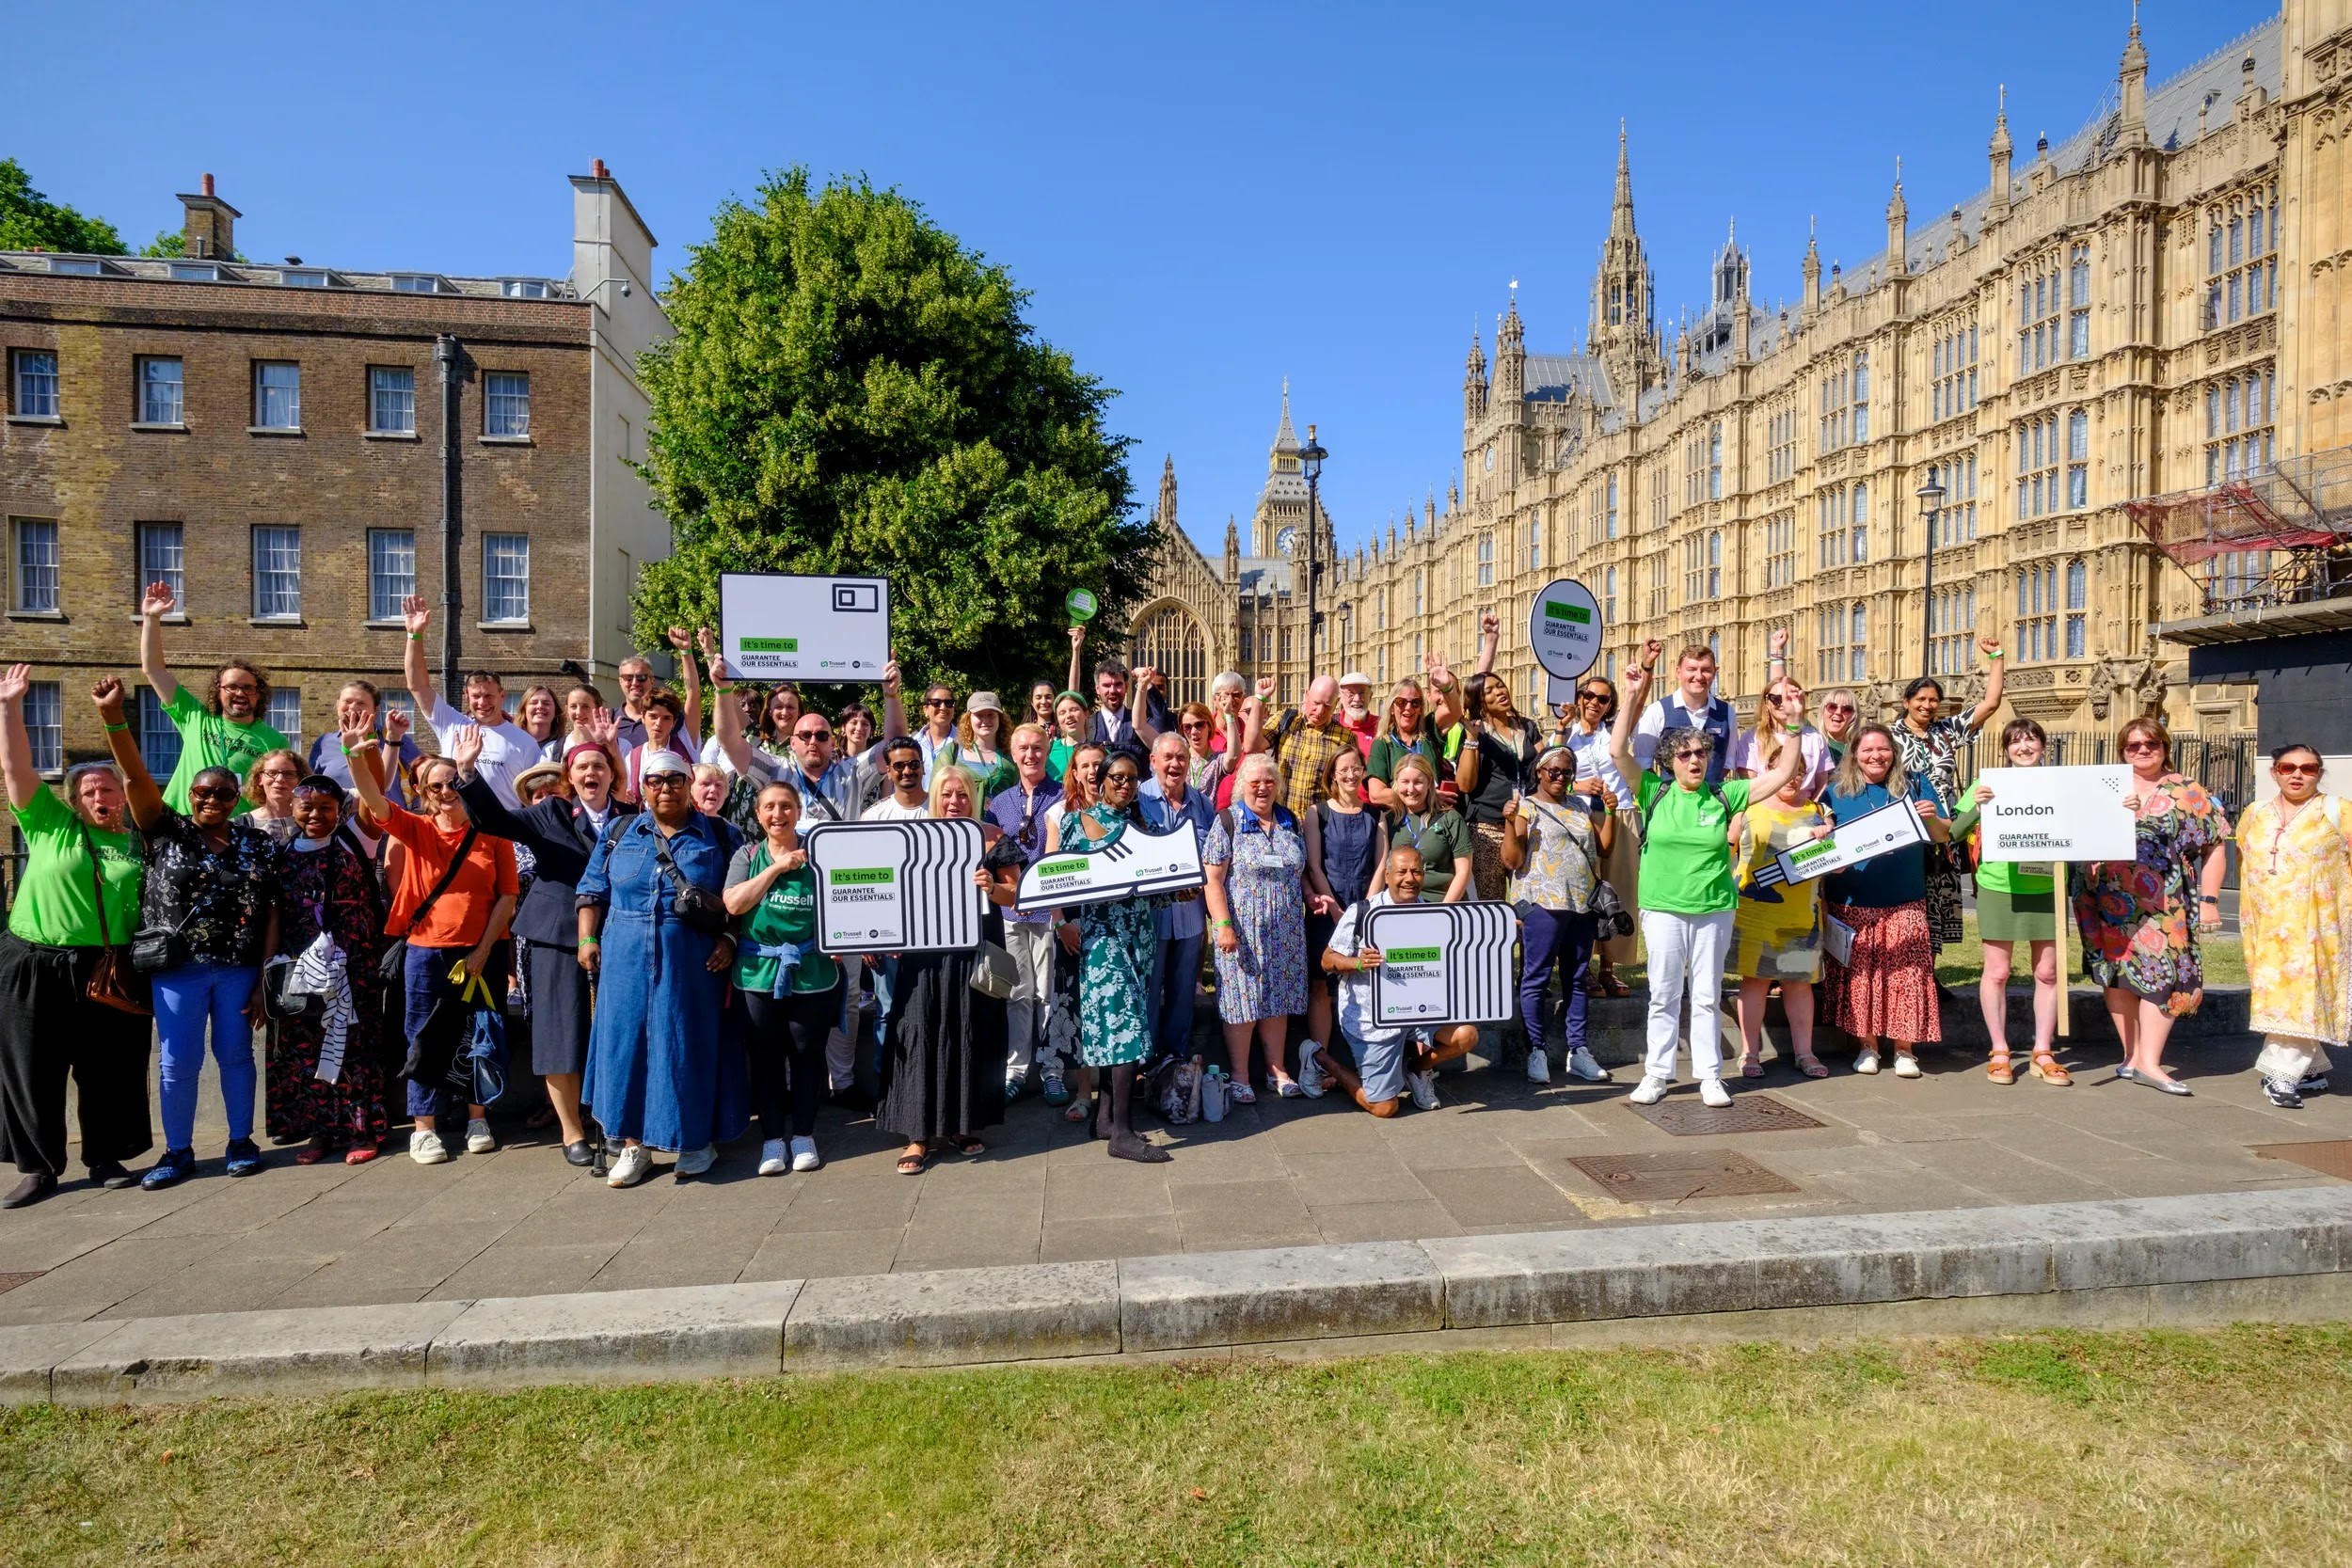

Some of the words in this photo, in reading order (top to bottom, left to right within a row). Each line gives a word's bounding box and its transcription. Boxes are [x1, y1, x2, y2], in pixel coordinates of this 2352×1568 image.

[1548, 605, 1560, 614] It's
[1561, 608, 1579, 618] time
[1545, 620, 1576, 632] GUARANTEE
[1557, 629, 1588, 641] ESSENTIALS
[744, 641, 758, 649] It's
[760, 641, 782, 649] time
[1996, 804, 2055, 816] London
[1792, 853, 1806, 863] It's
[1805, 847, 1823, 857] time
[1041, 864, 1055, 874] It's
[1056, 863, 1075, 872] time
[1796, 856, 1827, 871] GUARANTEE
[1798, 867, 1810, 876] OUR
[1809, 856, 1841, 871] ESSENTIALS
[834, 872, 850, 881] It's
[852, 871, 876, 880] time
[878, 871, 889, 879] to
[1040, 875, 1075, 885] GUARANTEE
[1055, 879, 1090, 889] ESSENTIALS
[770, 890, 814, 906] Trussell
[1390, 951, 1404, 959] It's
[1405, 951, 1426, 959] time
[1426, 950, 1438, 958] to
